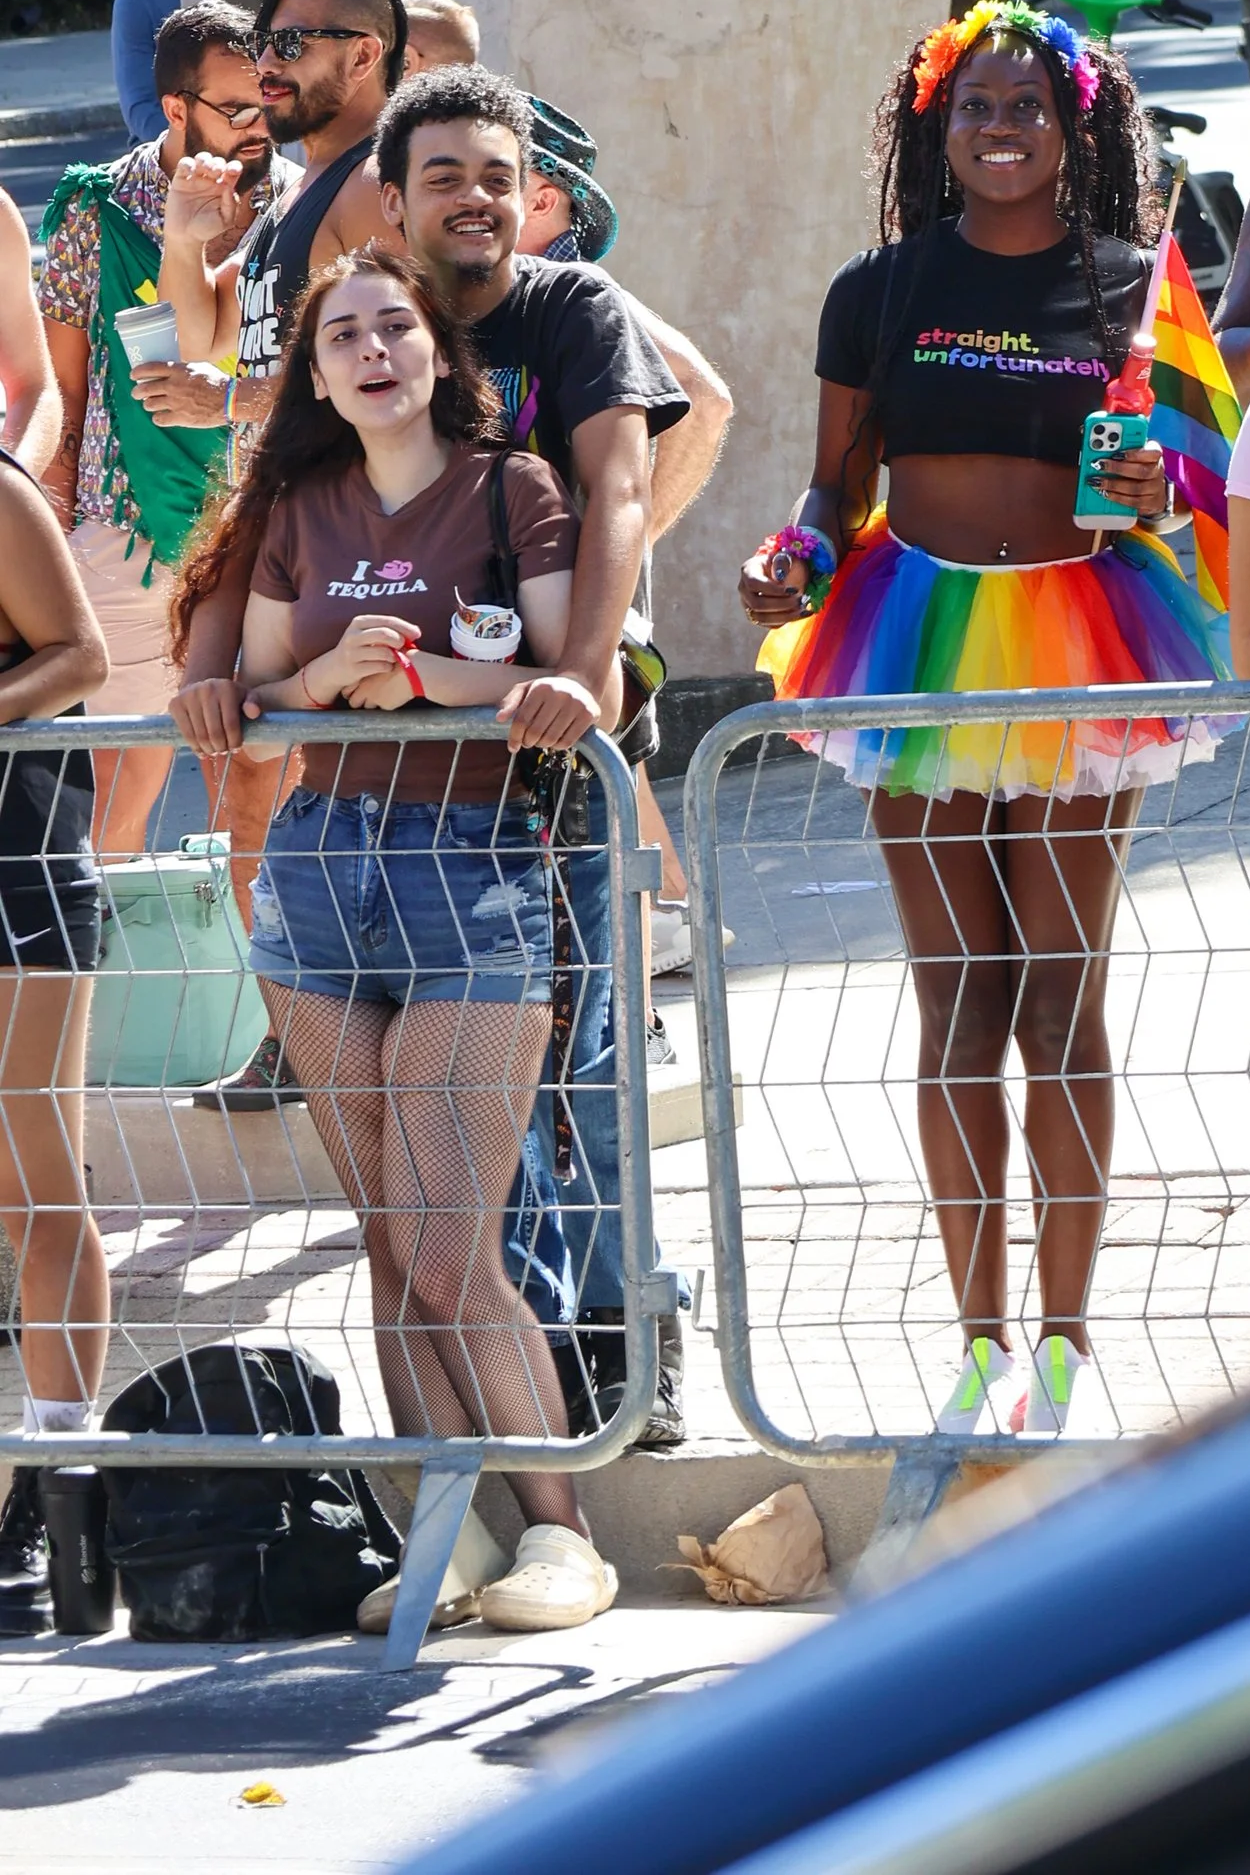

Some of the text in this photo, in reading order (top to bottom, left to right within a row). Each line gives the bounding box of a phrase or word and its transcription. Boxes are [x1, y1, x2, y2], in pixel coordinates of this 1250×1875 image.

[916, 328, 1040, 354] straight,
[913, 347, 1111, 382] unfortunately
[351, 560, 372, 582] I
[326, 578, 428, 600] TEQUILA
